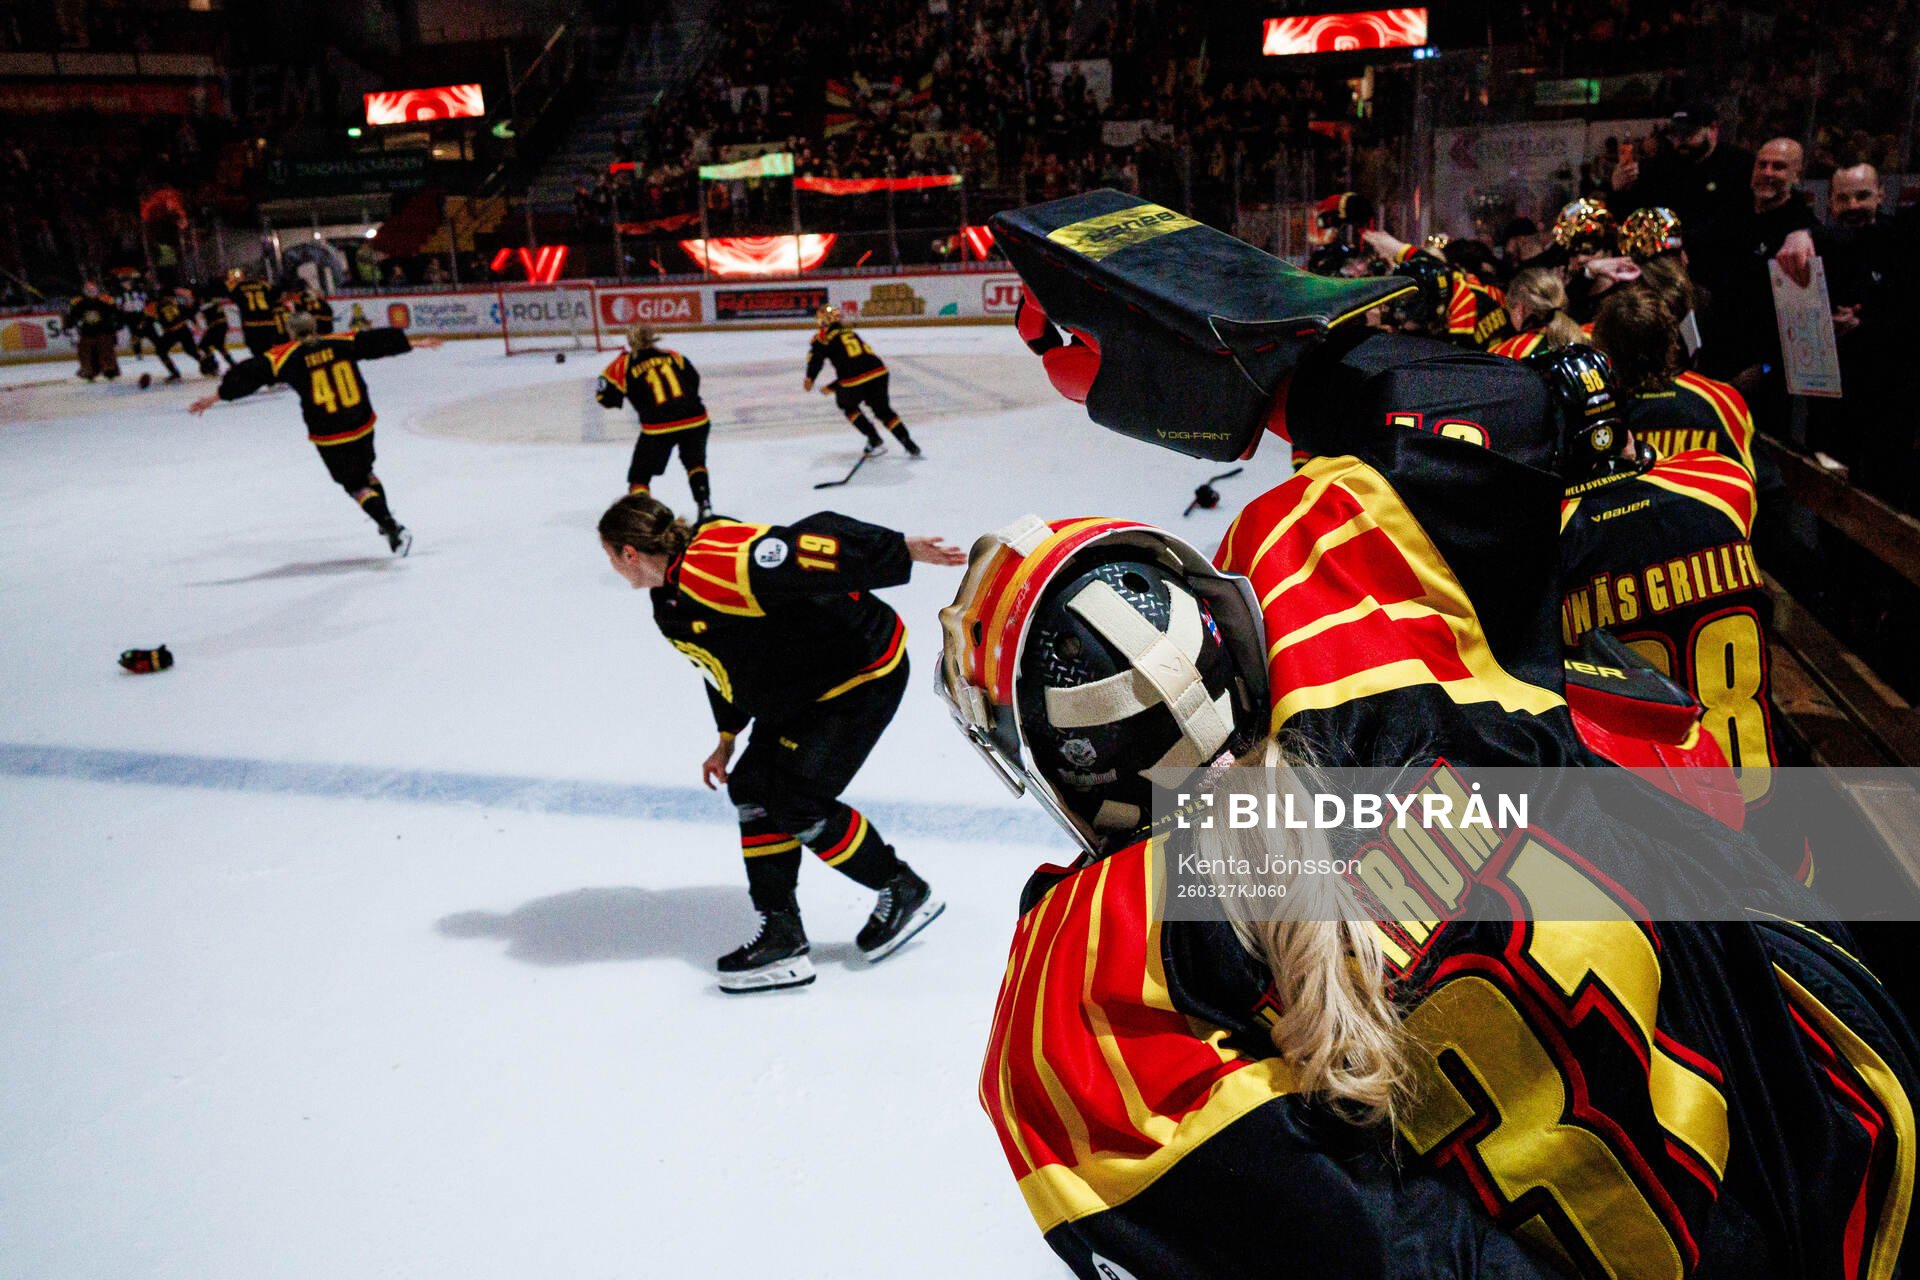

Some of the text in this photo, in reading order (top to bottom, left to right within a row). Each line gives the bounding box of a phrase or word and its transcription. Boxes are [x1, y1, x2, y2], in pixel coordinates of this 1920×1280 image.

[637, 298, 692, 319] GIDA
[311, 360, 361, 413] 40
[1580, 368, 1605, 393] 98
[1636, 429, 1718, 457] NIKKA
[1565, 484, 1587, 497] HELA
[1602, 499, 1650, 520] BAUER
[799, 534, 838, 571] 19
[1562, 575, 1640, 646] NÄS
